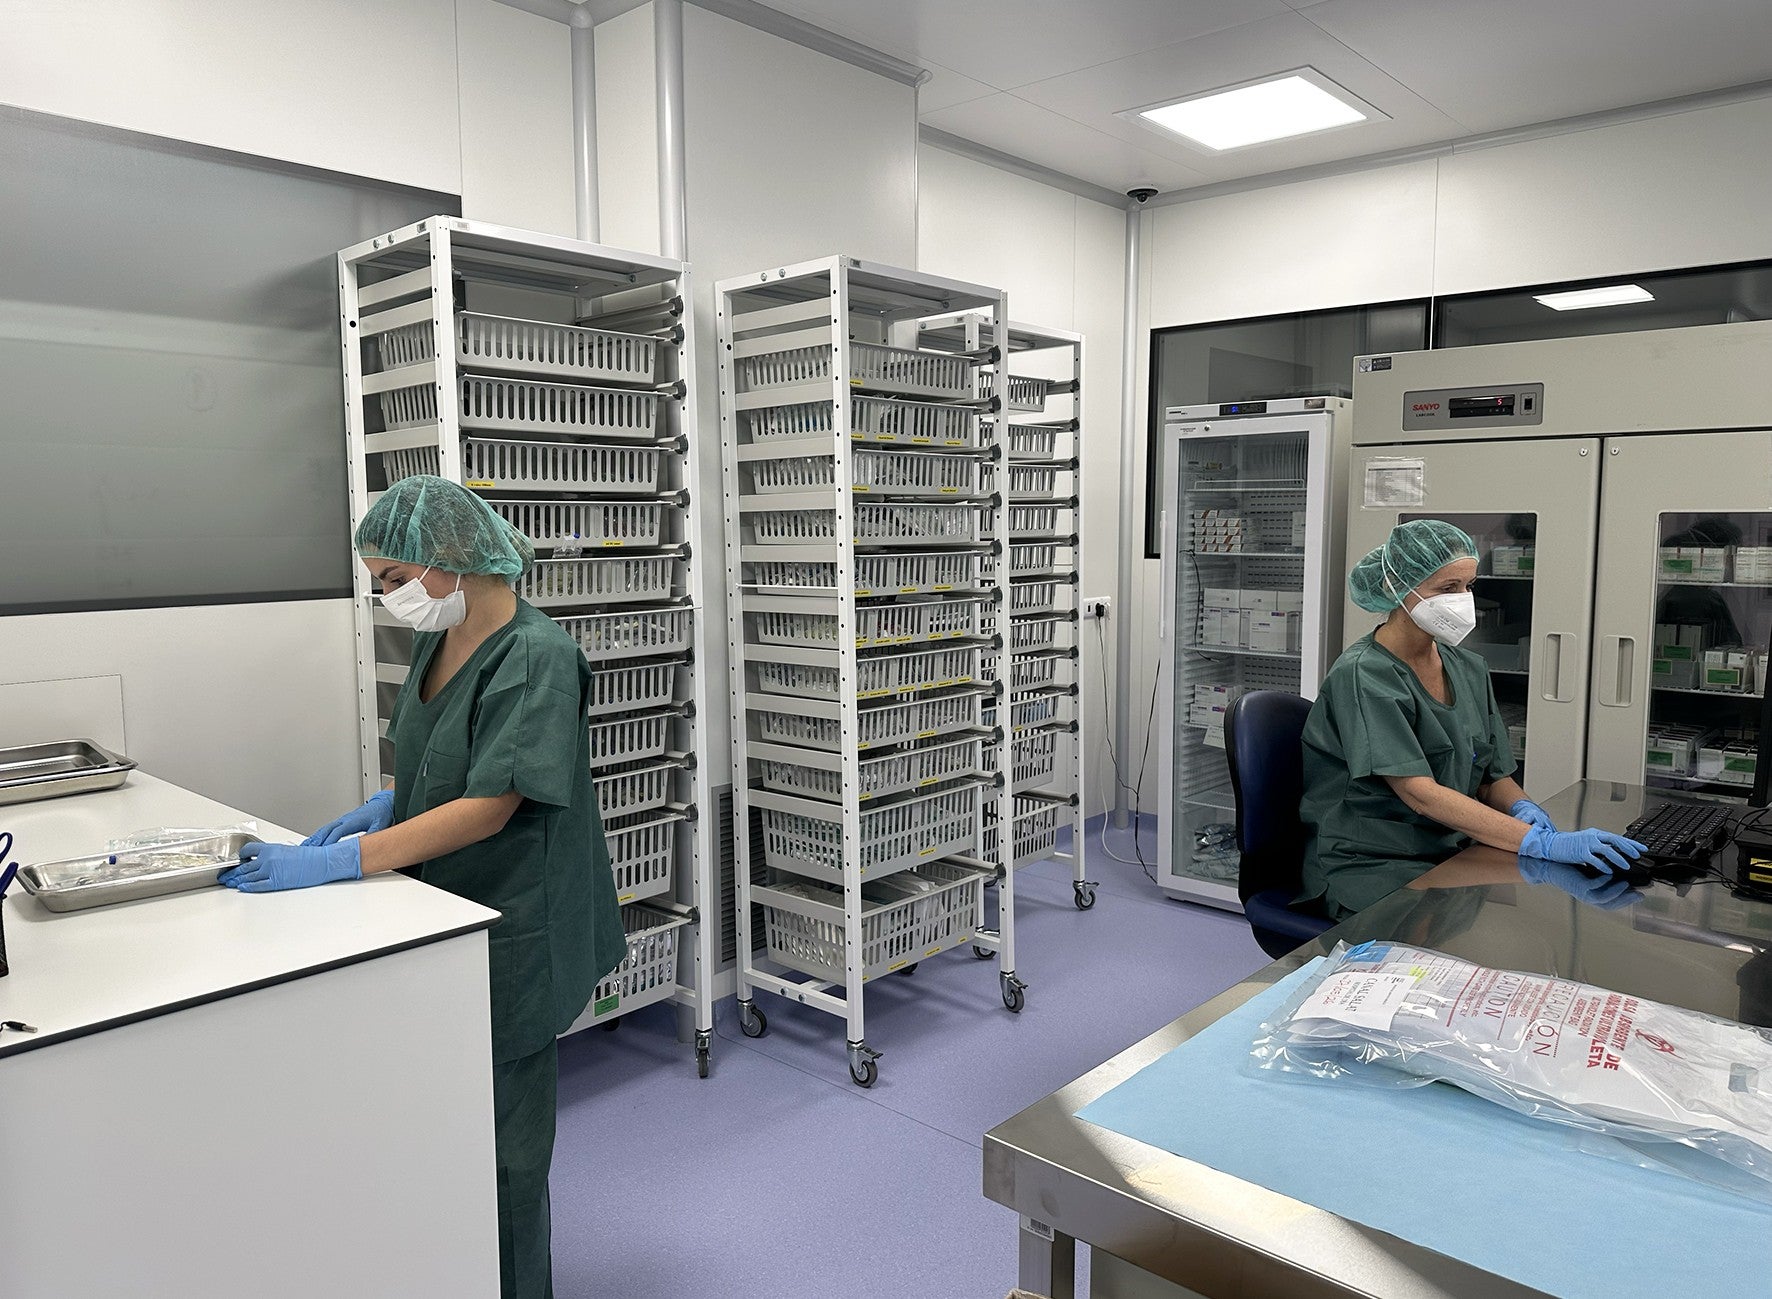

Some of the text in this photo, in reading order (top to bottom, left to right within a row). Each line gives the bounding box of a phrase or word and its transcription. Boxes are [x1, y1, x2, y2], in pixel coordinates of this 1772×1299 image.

[1412, 403, 1440, 412] SANYO
[1484, 975, 1521, 1019] CAUTION
[1603, 1053, 1621, 1071] DE
